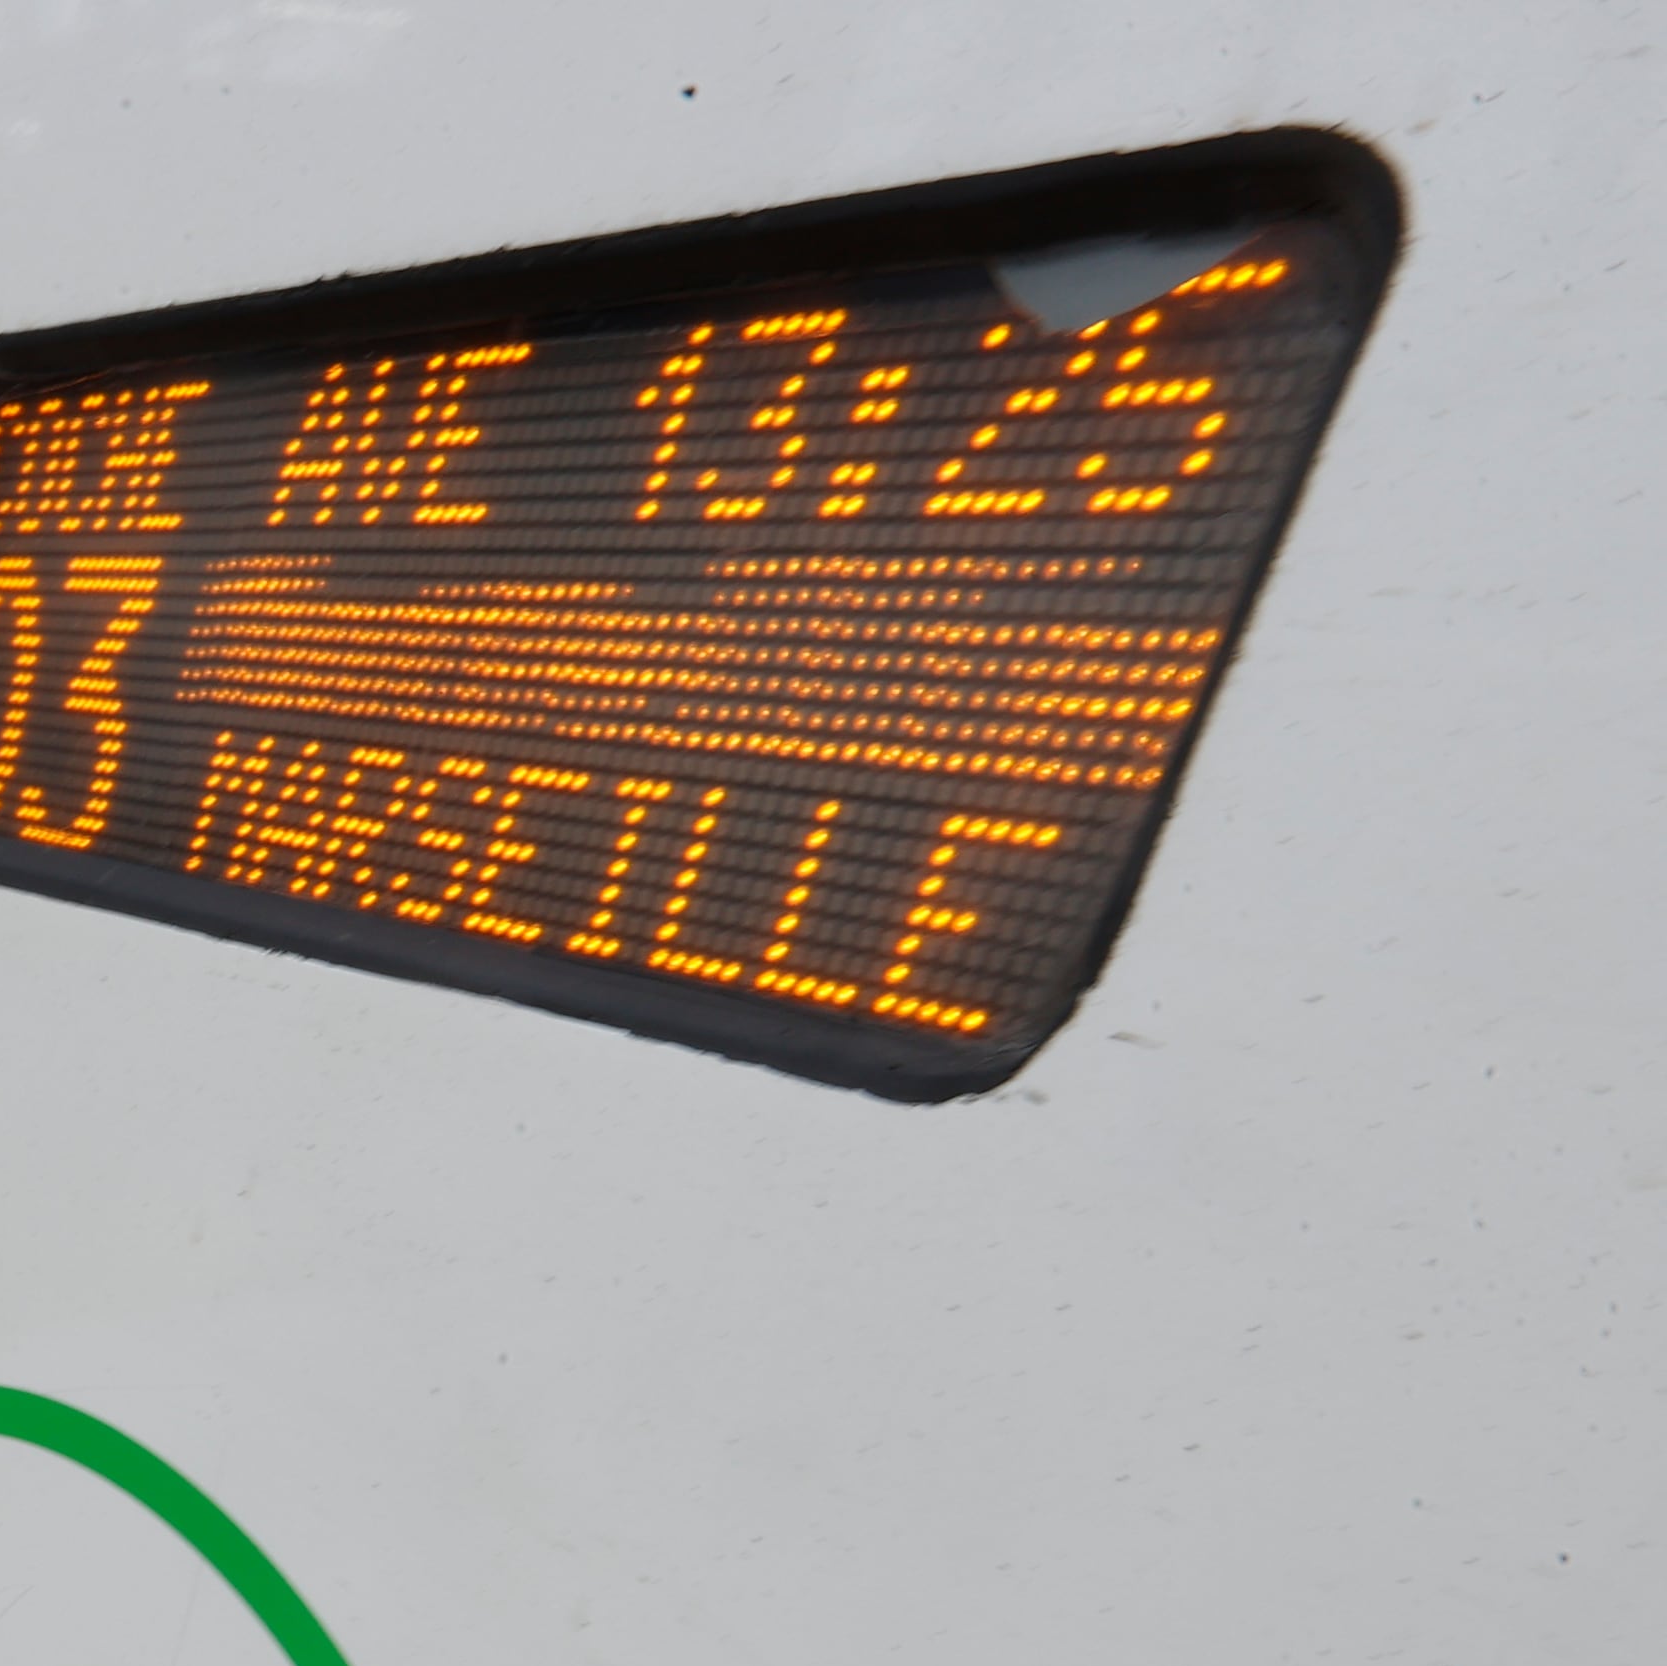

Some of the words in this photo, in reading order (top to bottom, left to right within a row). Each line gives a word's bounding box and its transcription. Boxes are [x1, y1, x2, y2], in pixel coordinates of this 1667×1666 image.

[266, 343, 533, 526] AVE
[636, 257, 1288, 522] 13:25
[184, 729, 1063, 1034] MARSEILLE
